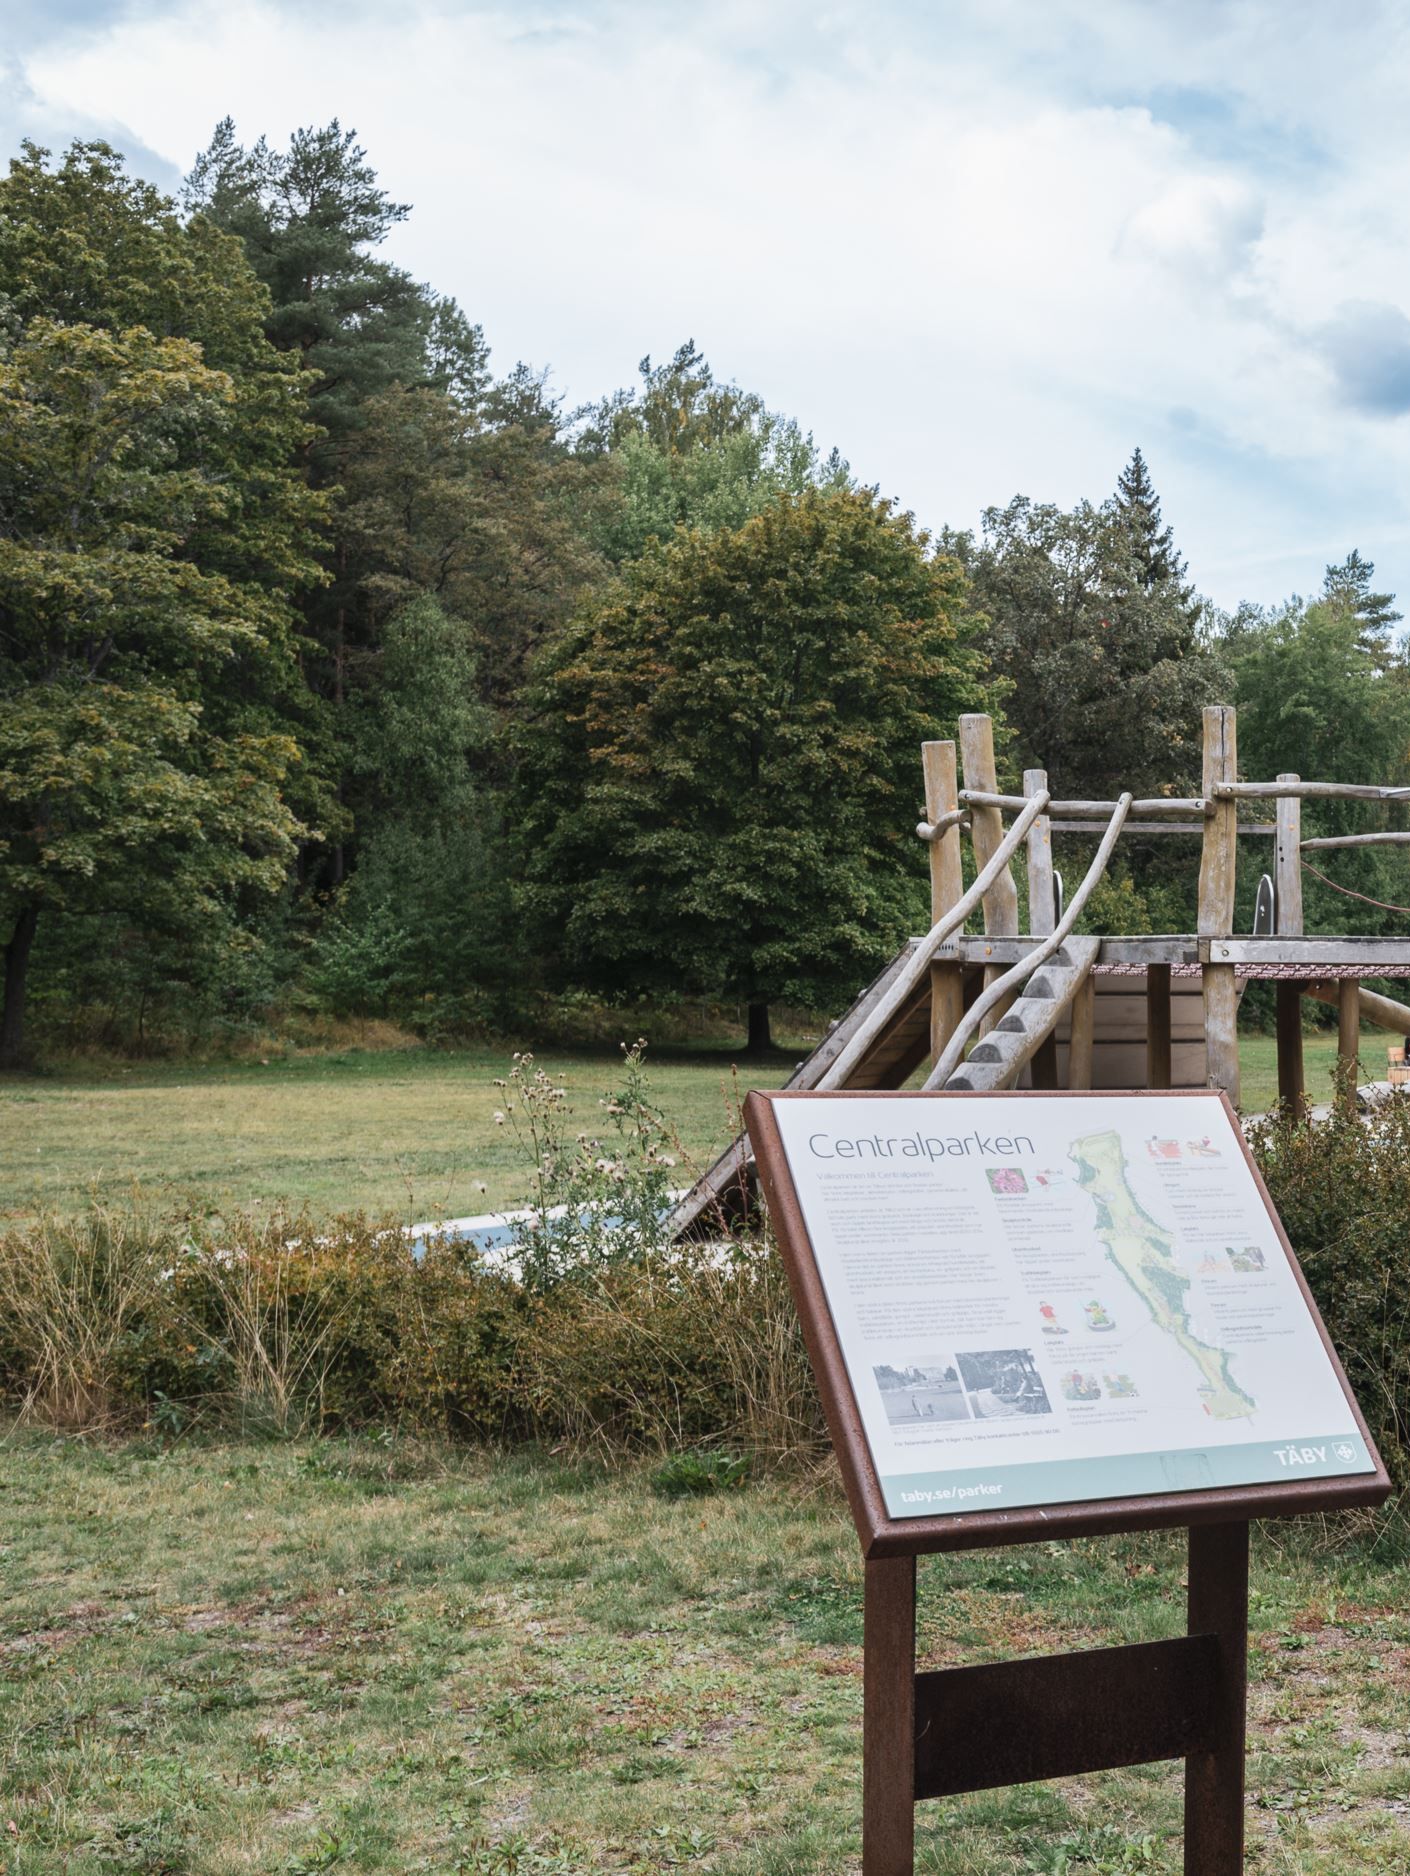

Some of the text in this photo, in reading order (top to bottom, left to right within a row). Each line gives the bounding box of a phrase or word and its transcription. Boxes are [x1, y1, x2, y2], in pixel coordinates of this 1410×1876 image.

[808, 1131, 1036, 1163] Centralparken
[1273, 1445, 1328, 1466] TÄBY
[901, 1484, 1003, 1502] taby.se/parker
